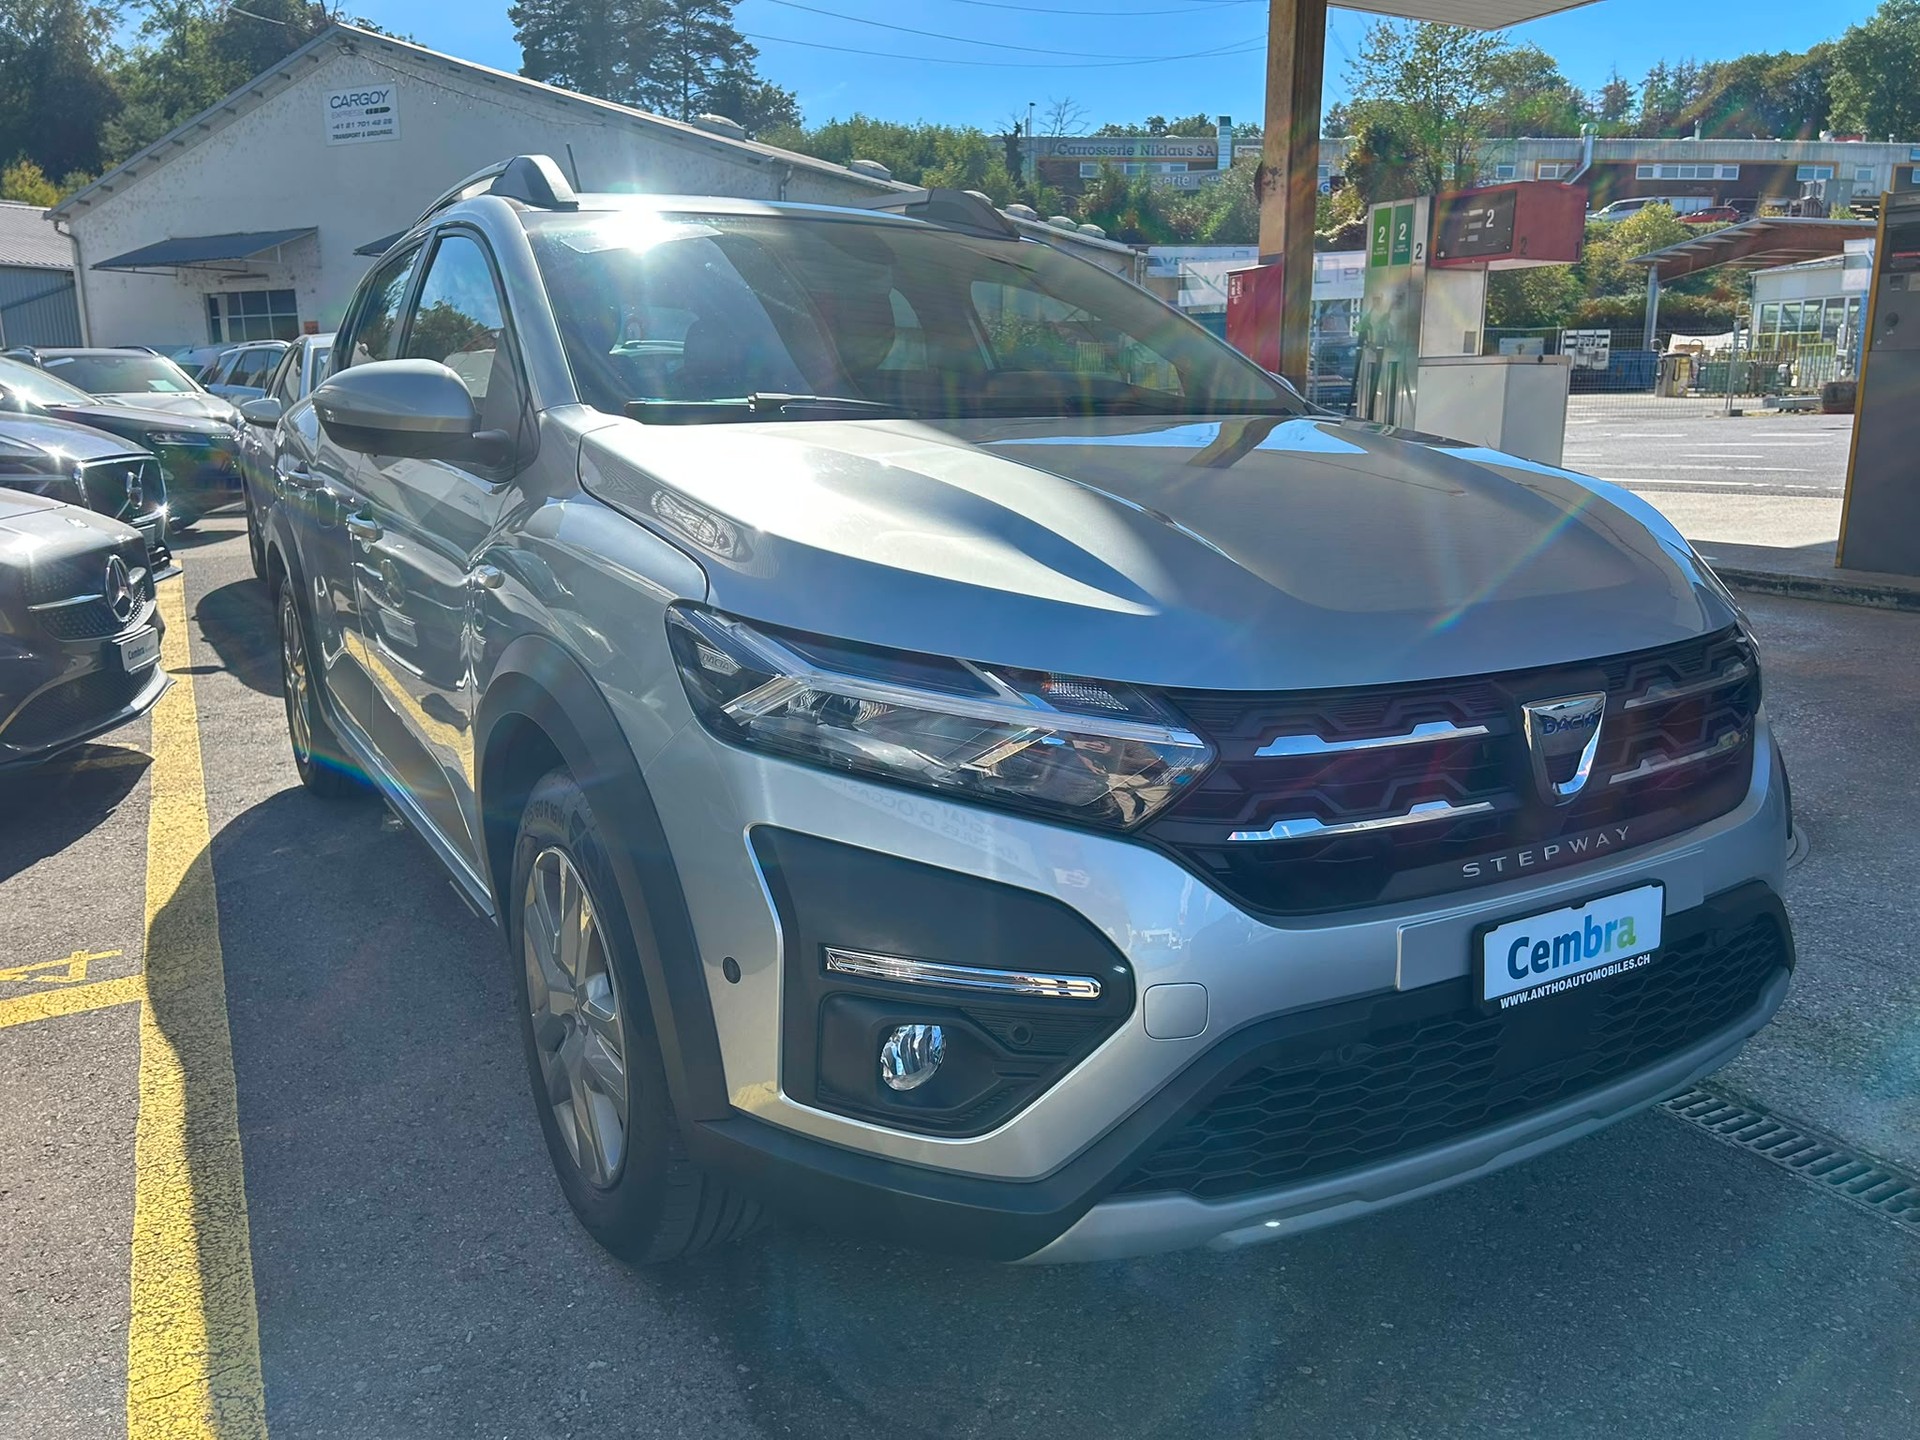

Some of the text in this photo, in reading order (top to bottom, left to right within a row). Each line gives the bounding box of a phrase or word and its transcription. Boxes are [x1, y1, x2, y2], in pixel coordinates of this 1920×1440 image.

[330, 89, 389, 108] CARGOY
[1056, 143, 1215, 157] Carrosserie Niklaus SA
[1485, 209, 1495, 228] 2
[1378, 226, 1386, 243] 2
[1398, 222, 1407, 241] 2
[1415, 242, 1423, 260] 2
[1541, 713, 1597, 735] DACIA
[1462, 825, 1630, 878] STEPWAY
[1507, 914, 1637, 980] Cembra
[1500, 953, 1651, 1010] WWW.ANTHOAUTOMOBILES.CH
